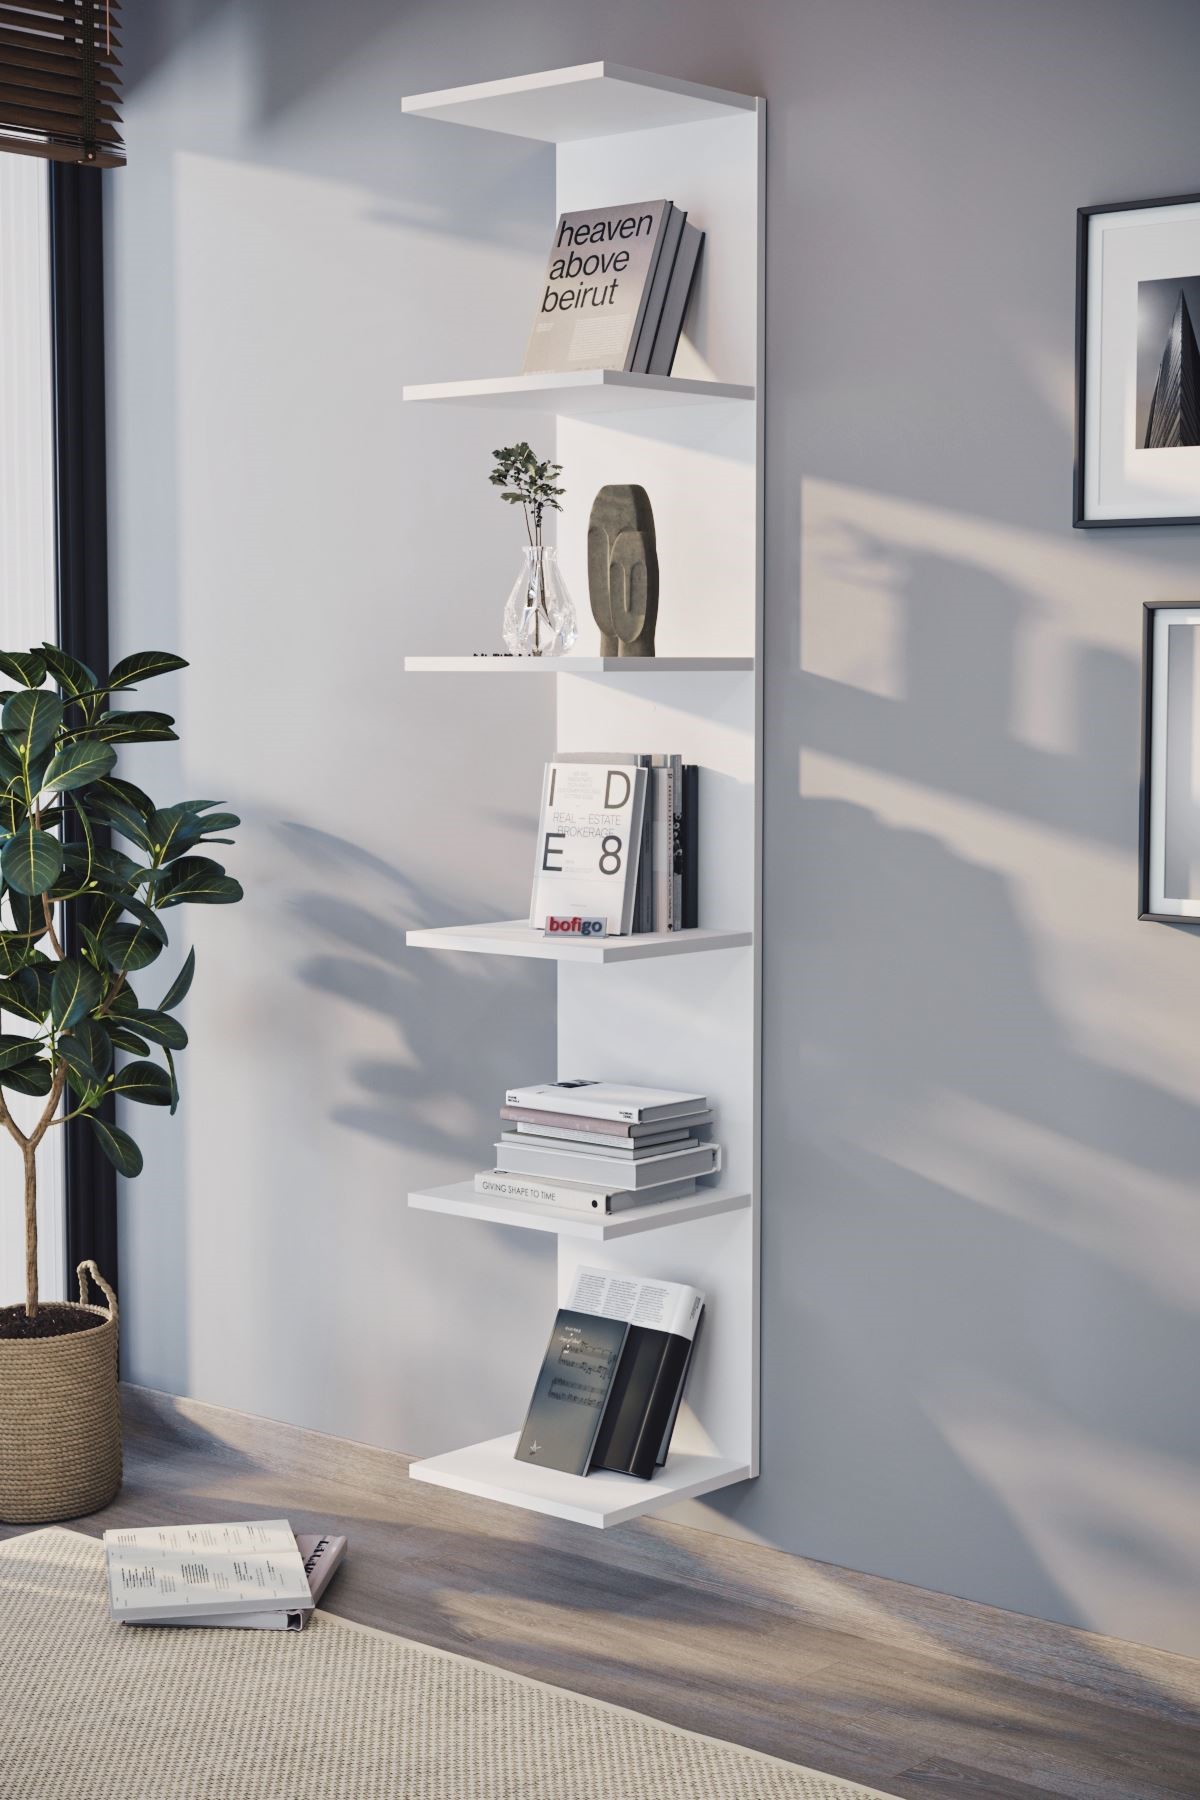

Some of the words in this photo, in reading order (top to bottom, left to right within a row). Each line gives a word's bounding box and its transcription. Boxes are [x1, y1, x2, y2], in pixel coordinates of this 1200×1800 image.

[556, 214, 653, 248] heaven
[549, 250, 630, 280] above
[541, 278, 619, 313] beirut
[548, 768, 557, 807] I
[604, 770, 631, 809] D
[553, 812, 576, 823] REAL
[588, 814, 621, 825] ESTATE
[557, 825, 616, 839] BROKERAGE
[542, 832, 566, 872] E
[599, 835, 622, 875] 8
[549, 916, 603, 936] bofigo
[482, 1181, 507, 1193] GIVING
[508, 1185, 529, 1197] SHAPE
[530, 1189, 540, 1199] TO
[541, 1190, 556, 1201] TIME
